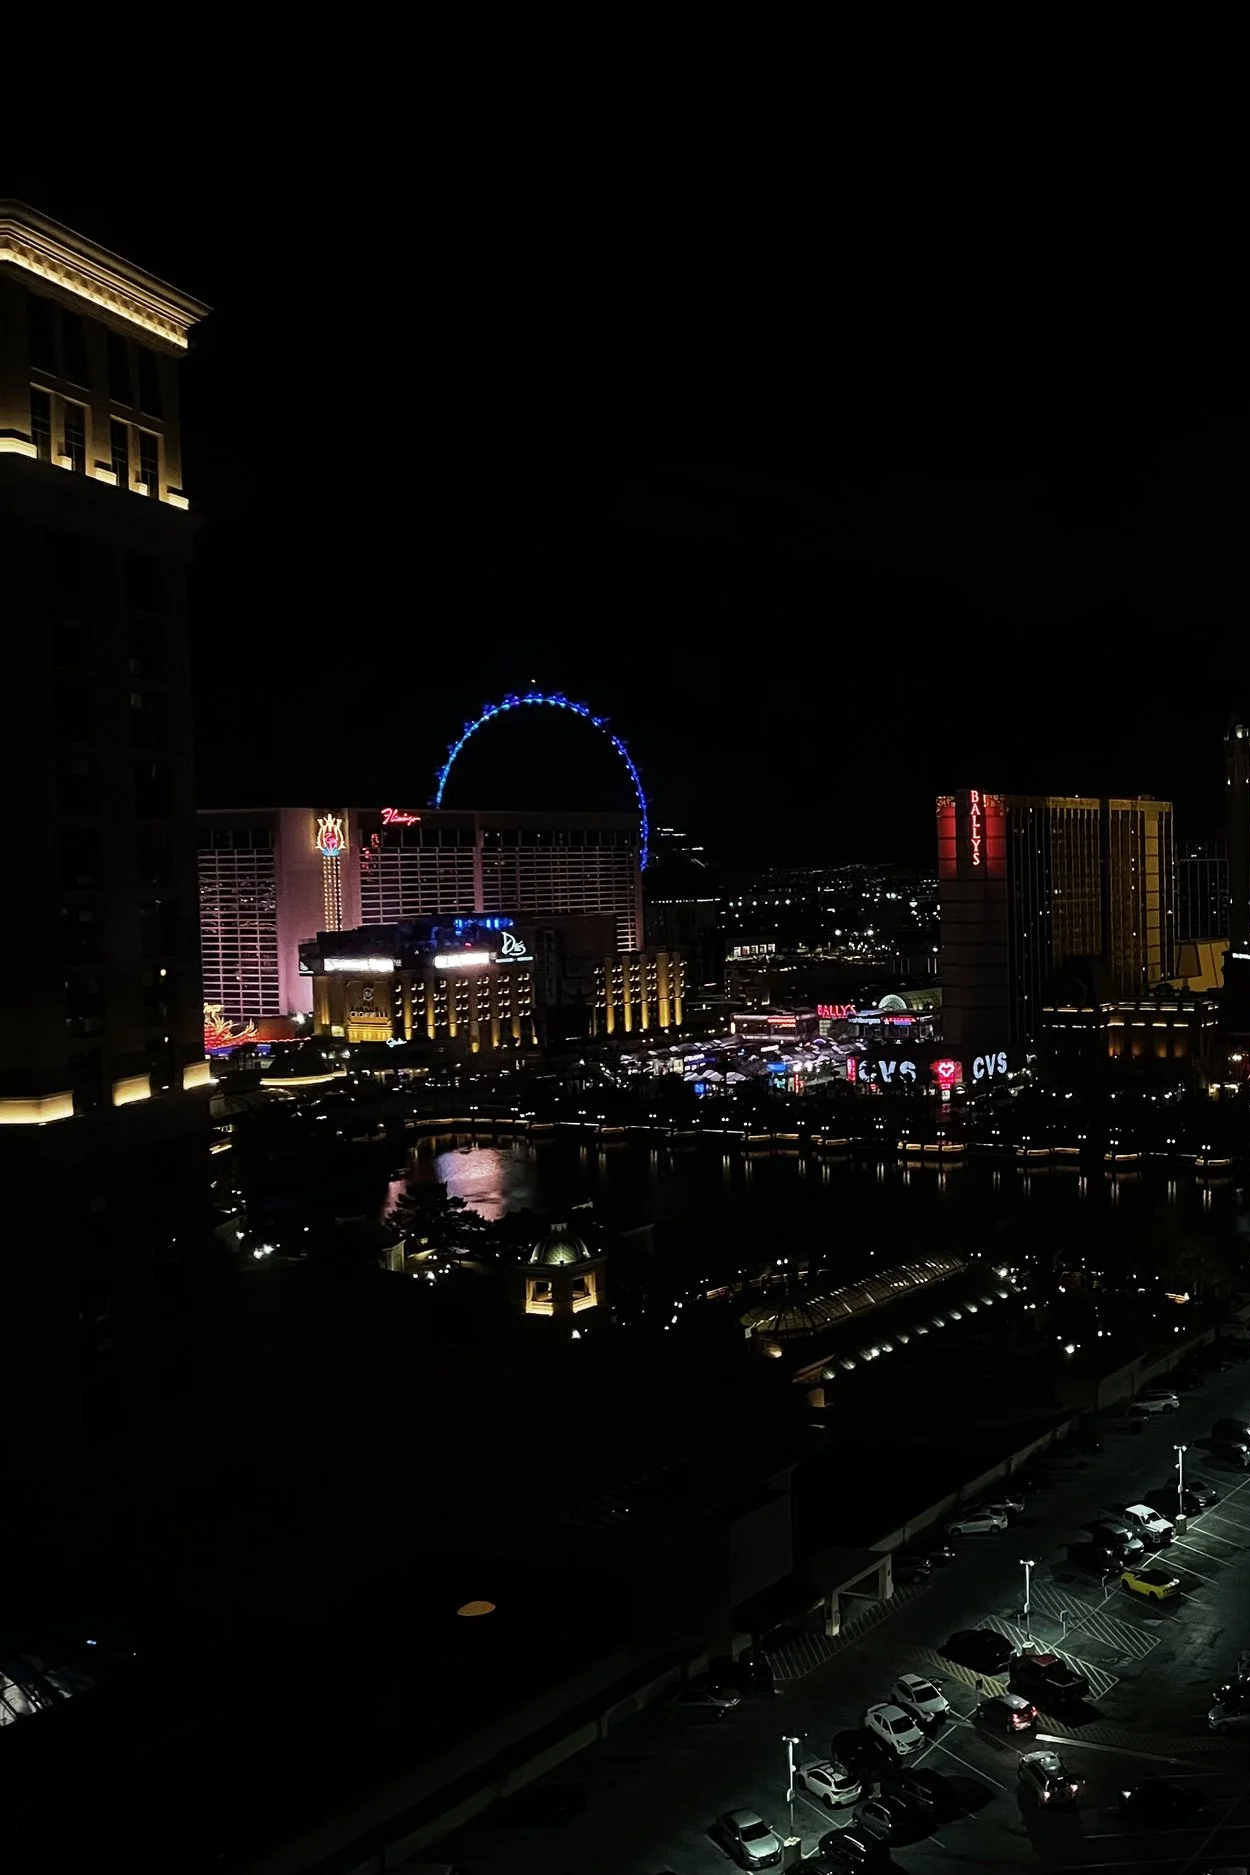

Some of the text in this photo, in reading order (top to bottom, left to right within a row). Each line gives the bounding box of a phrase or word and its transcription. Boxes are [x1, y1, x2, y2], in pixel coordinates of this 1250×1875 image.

[970, 790, 981, 866] BALLYS
[817, 1004, 856, 1018] BALLY'S
[858, 1060, 917, 1083] CVS
[973, 1051, 1007, 1079] CVS
